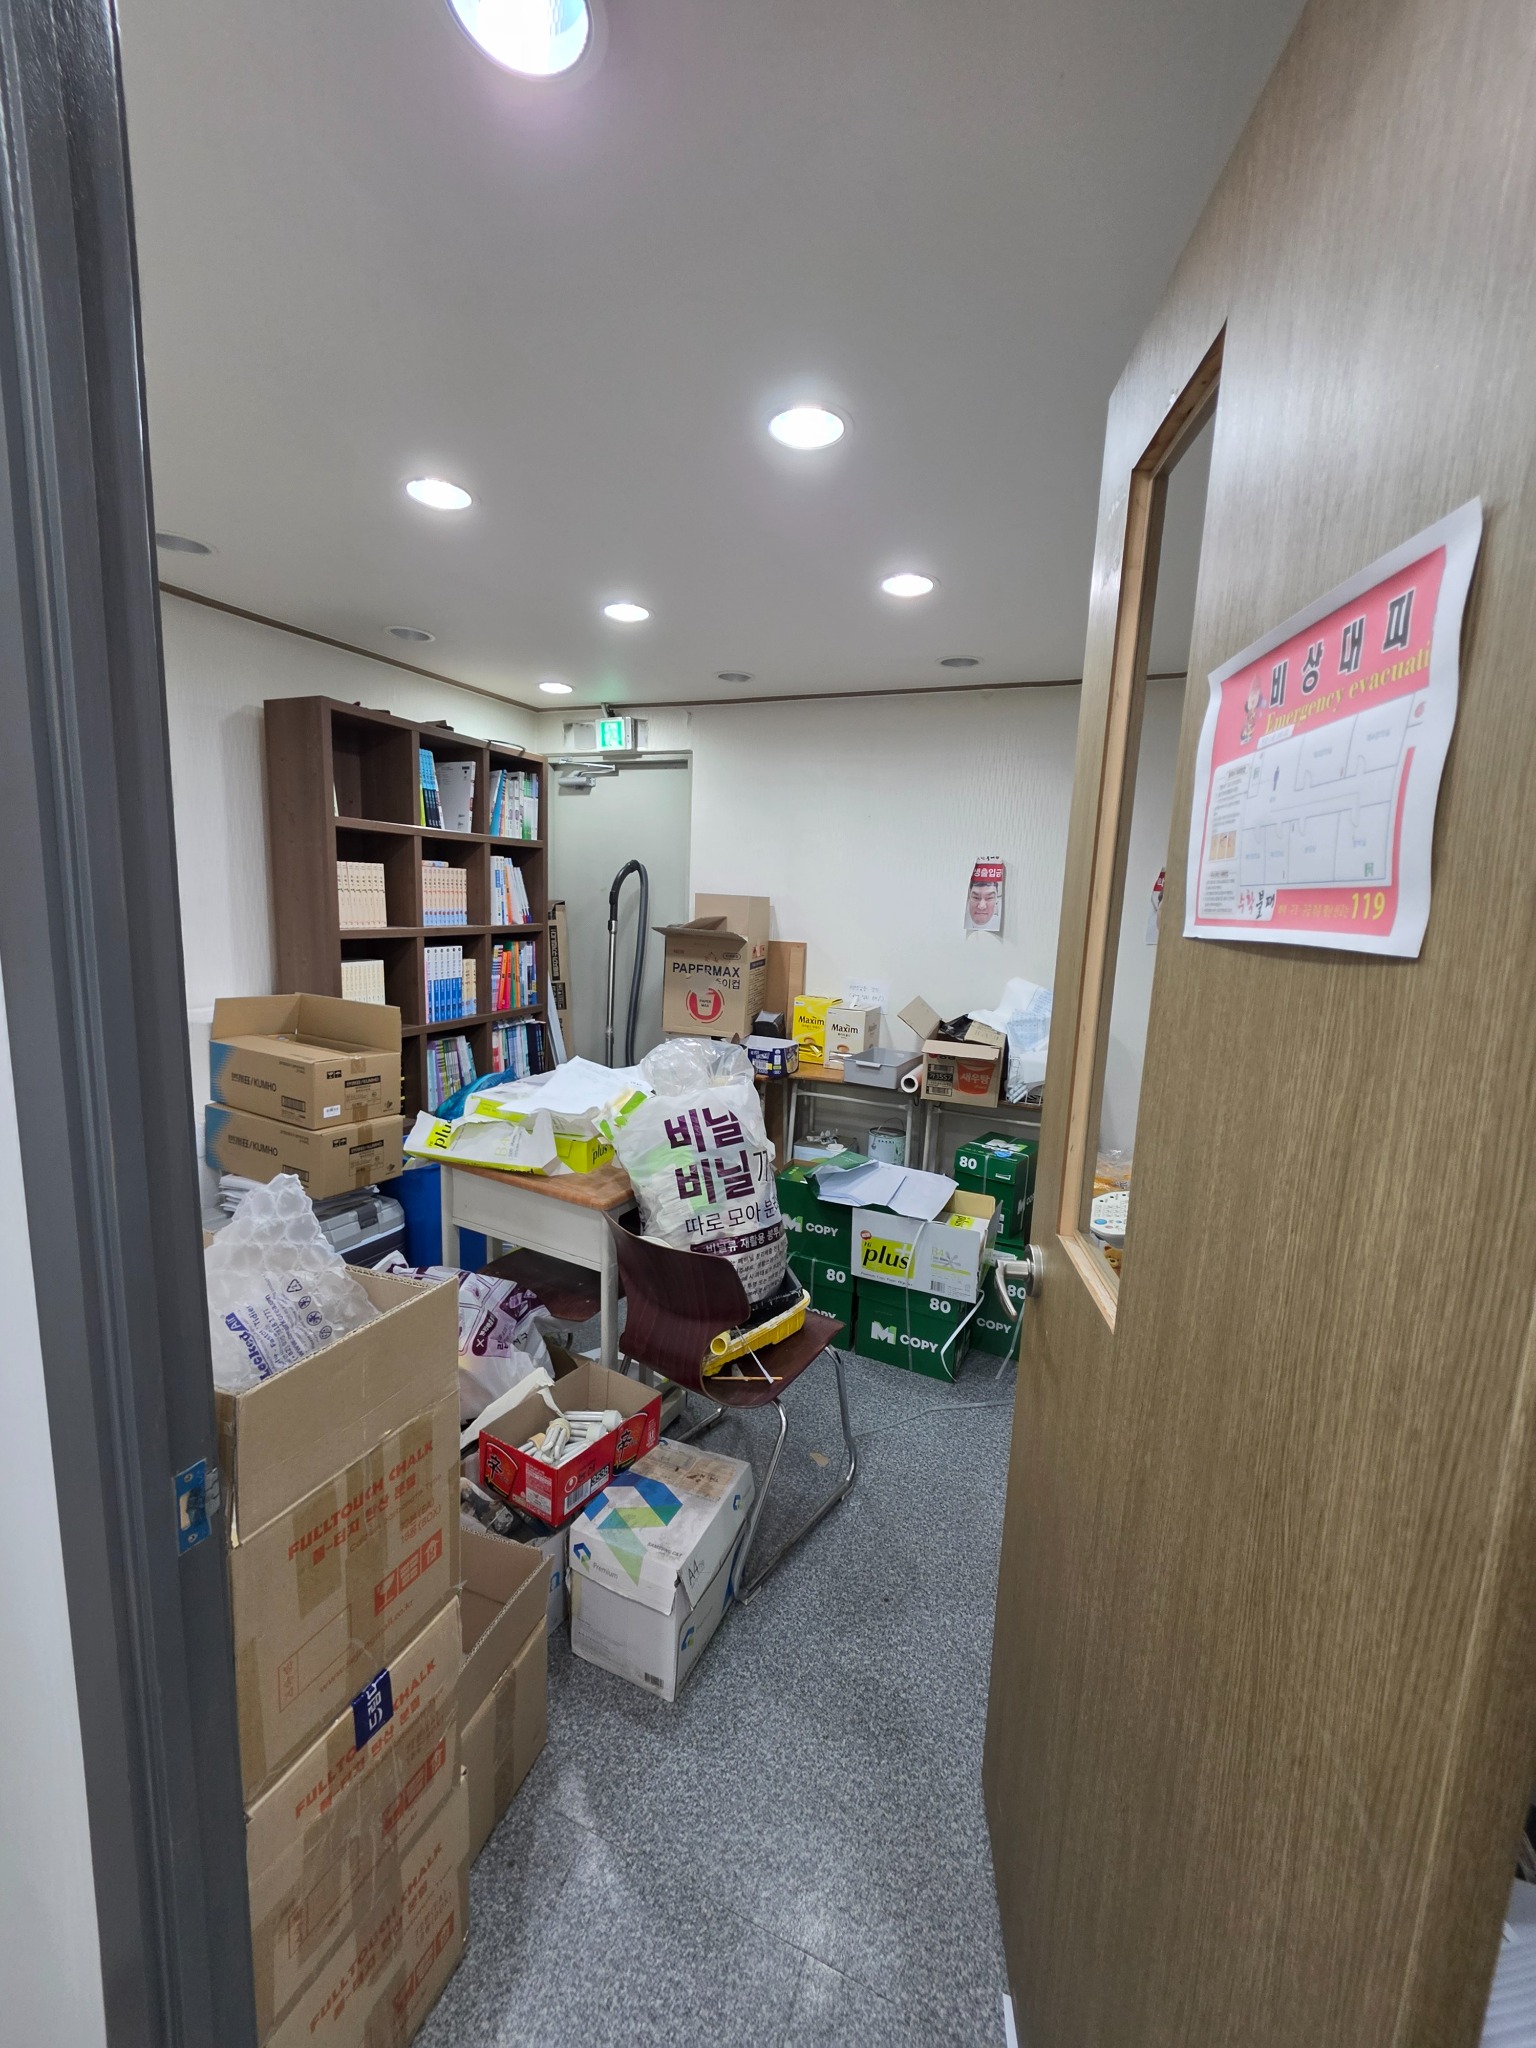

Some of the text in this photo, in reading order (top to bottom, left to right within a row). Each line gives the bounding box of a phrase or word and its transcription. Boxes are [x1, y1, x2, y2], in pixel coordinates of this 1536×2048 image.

[1264, 686, 1345, 734] Emergency
[1351, 891, 1386, 920] 119
[798, 1016, 825, 1026] Maxim
[831, 1024, 859, 1034] Maxim
[960, 1072, 990, 1085] 새우탕
[433, 1119, 452, 1150] plu
[663, 1107, 745, 1153] 비닐
[592, 1143, 609, 1165] plus
[959, 1156, 978, 1170] 80
[685, 1213, 725, 1235] 따로
[728, 1202, 761, 1226] 모아
[805, 1222, 839, 1237] COPY
[740, 1232, 766, 1249] 재활용
[862, 1245, 910, 1270] plus
[826, 1268, 846, 1284] 80
[1007, 1284, 1026, 1300] 80
[929, 1298, 952, 1314] 80
[870, 1320, 939, 1354] M COPY
[976, 1317, 1012, 1334] COPY
[238, 1331, 272, 1381] Locked
[288, 1440, 434, 1561] FULLTOUCH CHALK
[592, 1562, 619, 1580] Premium
[687, 1559, 699, 1586] A4
[295, 1744, 357, 1820] FULLTO
[393, 1657, 436, 1711] CHALK
[400, 1841, 442, 1903] CHALK
